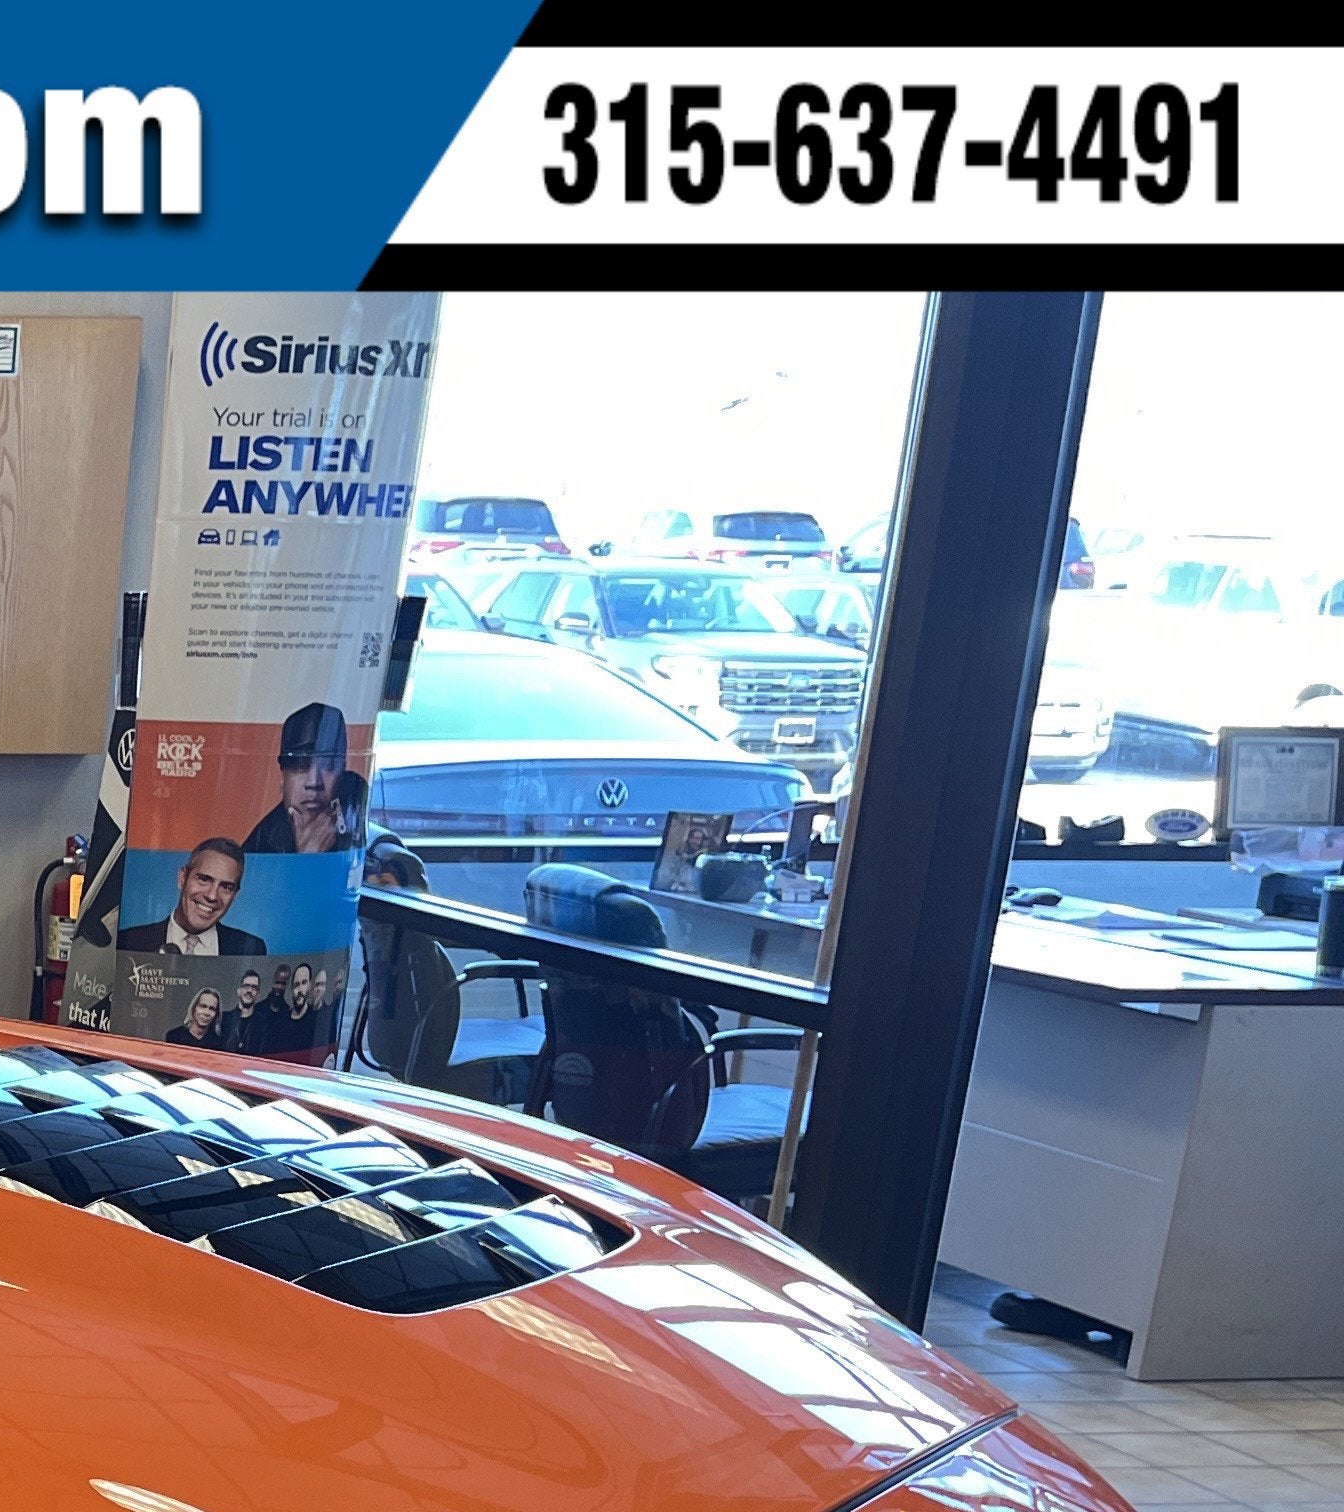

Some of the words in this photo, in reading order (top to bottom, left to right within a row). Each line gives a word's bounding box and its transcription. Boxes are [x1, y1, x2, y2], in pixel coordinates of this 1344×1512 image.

[213, 406, 265, 427] Your
[272, 408, 311, 427] trial
[208, 435, 374, 473] LISTEN
[157, 742, 203, 760] ROCK
[565, 817, 656, 827] JETTA
[73, 971, 107, 1000] Make
[69, 1001, 98, 1028] that
